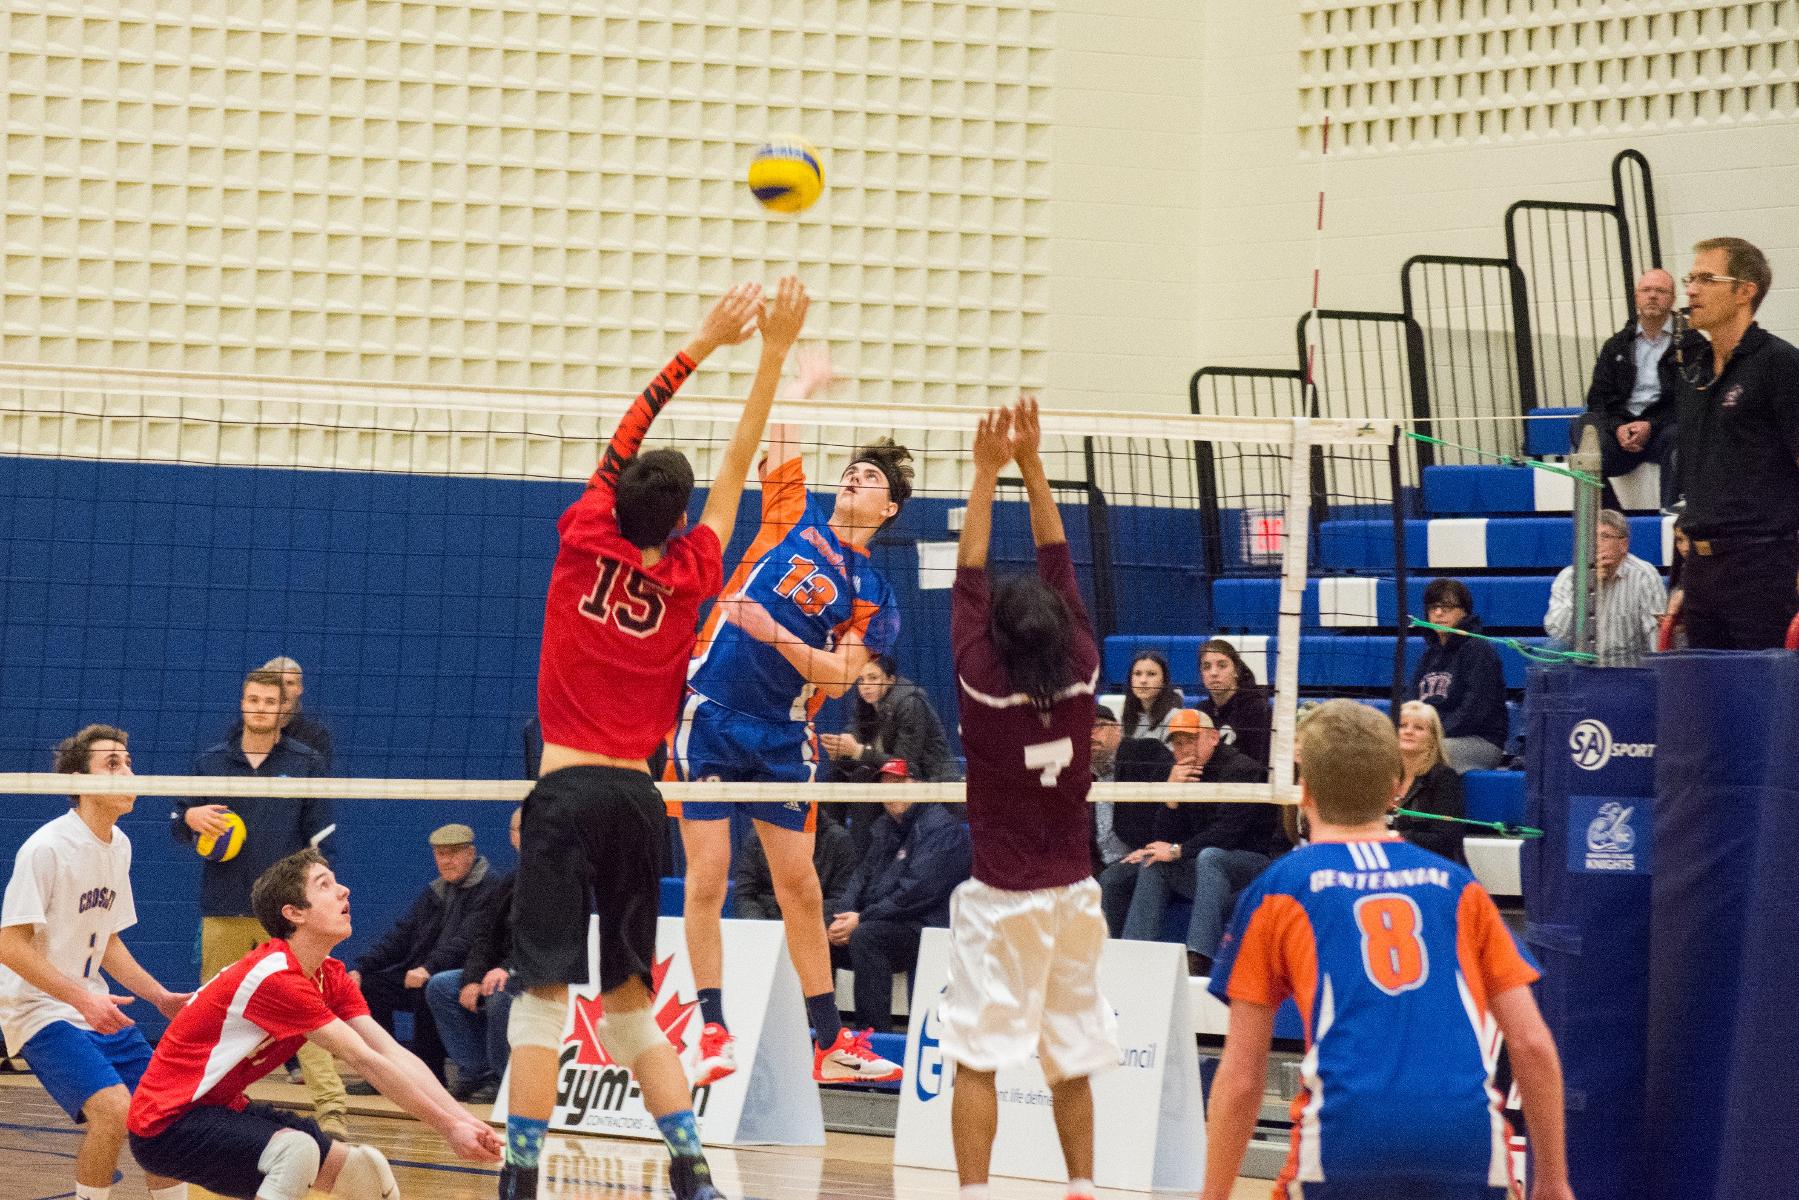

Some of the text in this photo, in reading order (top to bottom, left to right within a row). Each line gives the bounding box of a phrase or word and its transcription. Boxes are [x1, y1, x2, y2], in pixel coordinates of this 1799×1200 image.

[578, 555, 676, 639] 15
[773, 554, 838, 617] 13
[1610, 743, 1656, 757] SPORT
[1353, 892, 1430, 997] 8
